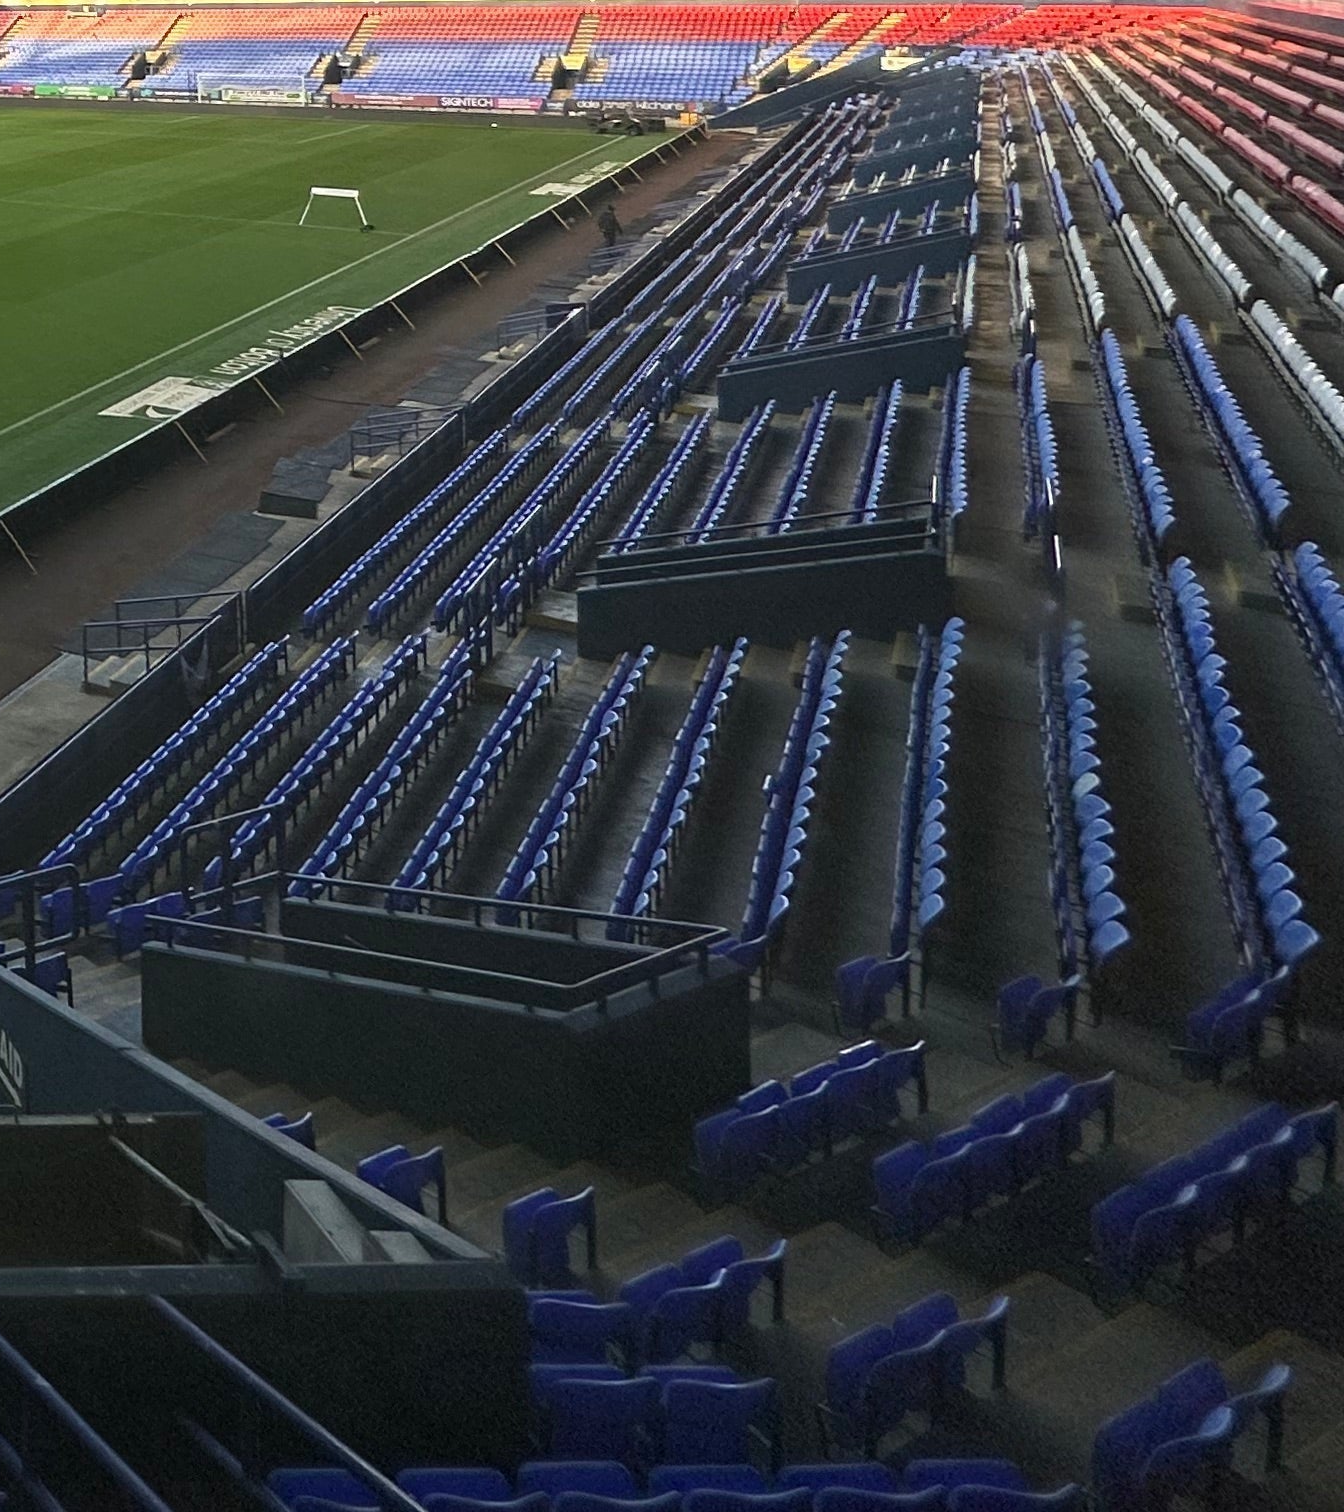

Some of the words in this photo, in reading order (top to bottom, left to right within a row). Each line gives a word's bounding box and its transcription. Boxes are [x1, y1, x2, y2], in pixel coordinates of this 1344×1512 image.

[440, 96, 493, 108] SIGNTECH
[577, 99, 601, 110] dale
[636, 100, 685, 112] kitchens
[268, 305, 363, 341] University
[210, 347, 280, 376] Bolton
[0, 1028, 23, 1089] AID
